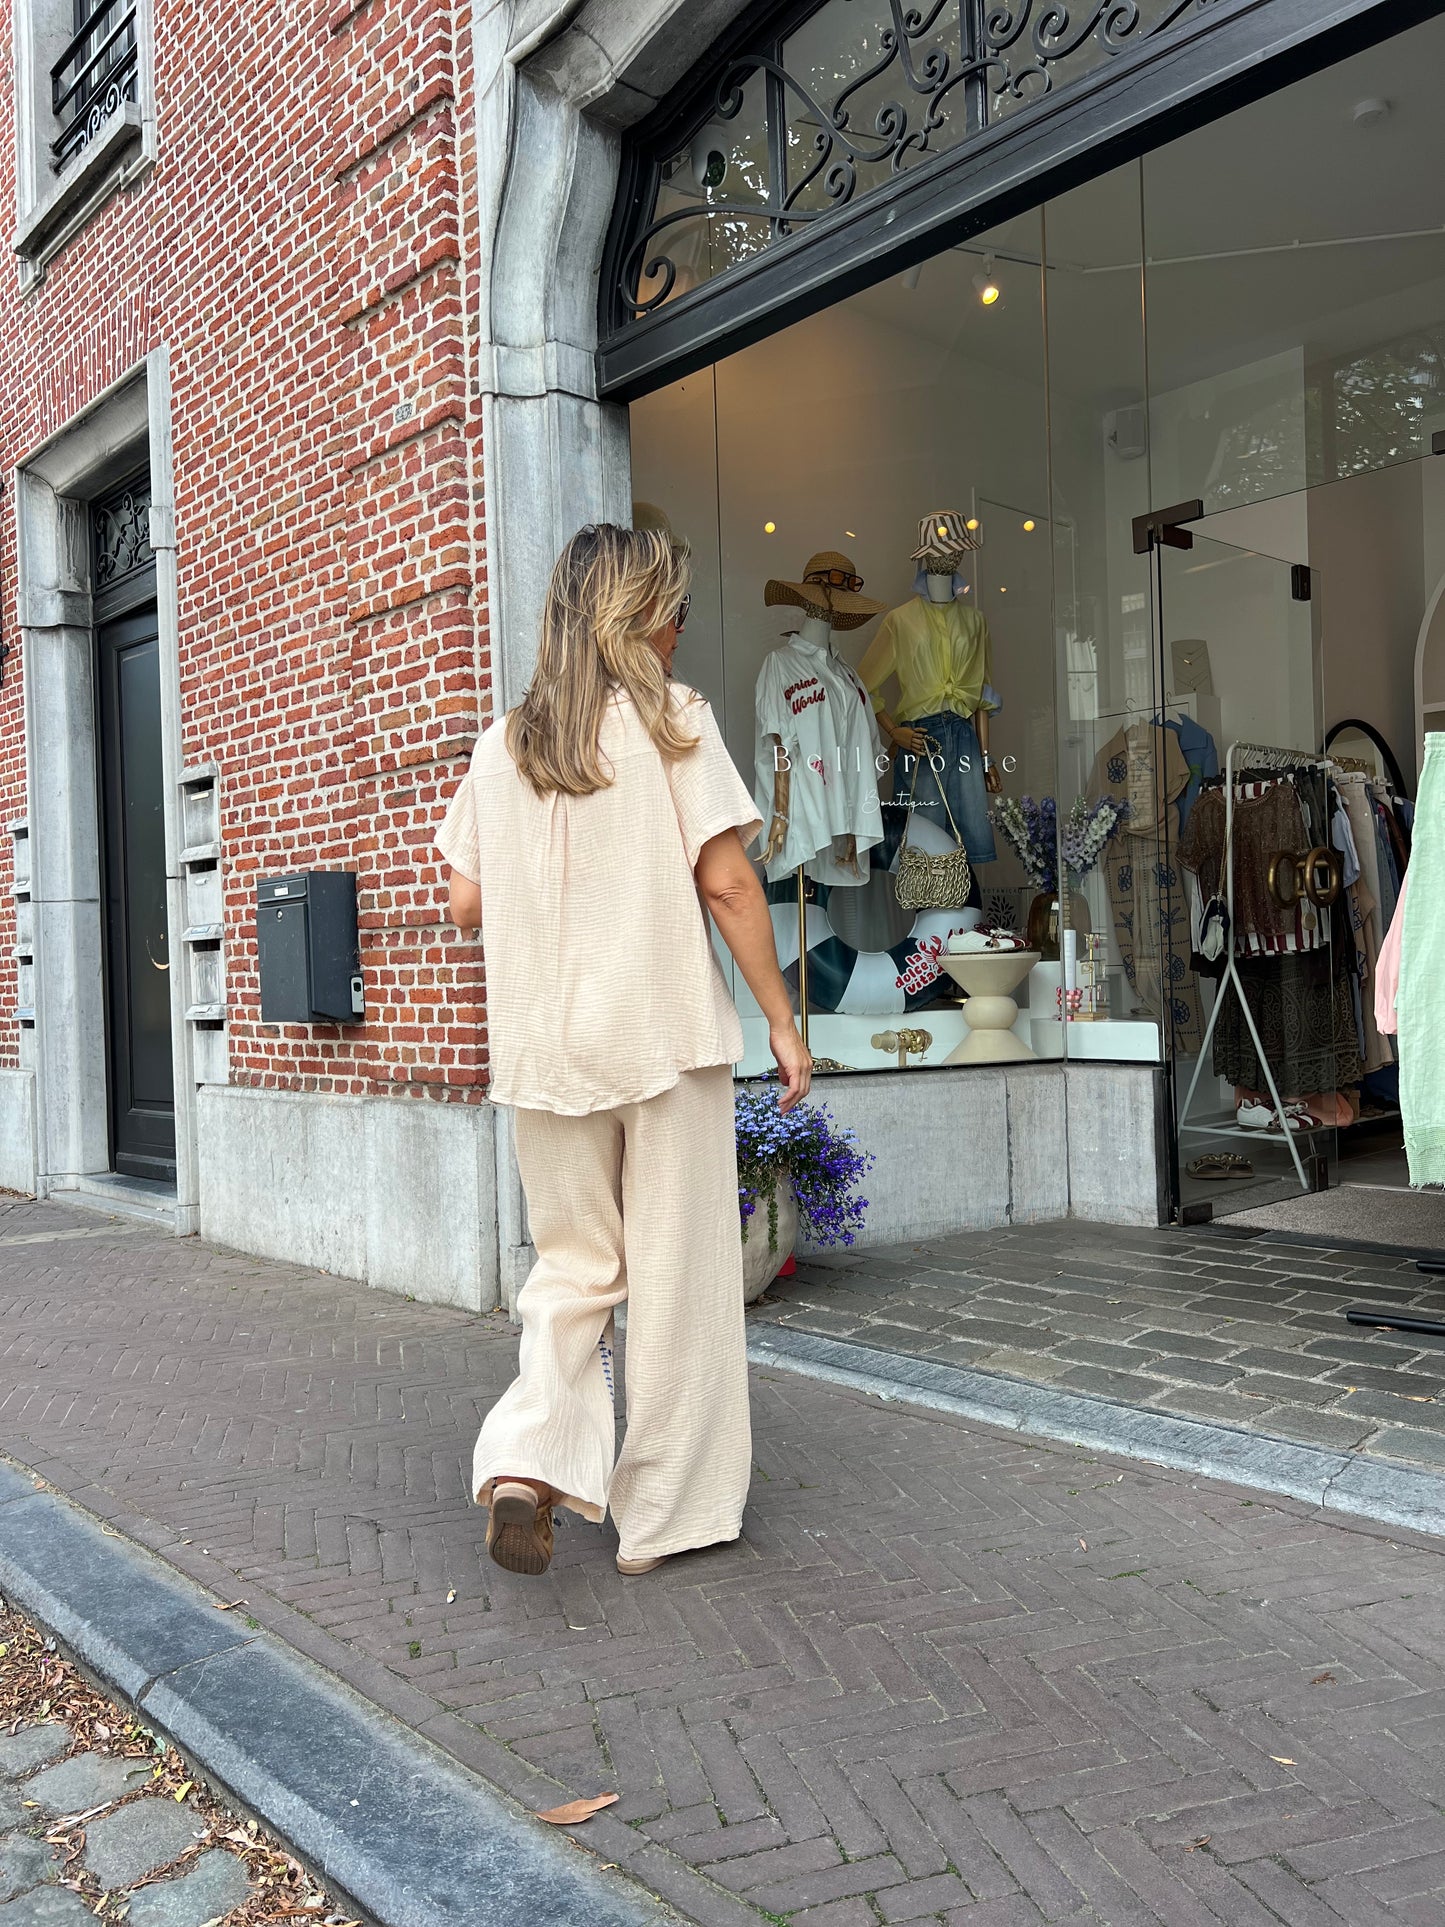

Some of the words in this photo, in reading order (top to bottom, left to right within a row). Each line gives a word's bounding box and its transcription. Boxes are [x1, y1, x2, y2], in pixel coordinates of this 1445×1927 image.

[791, 687, 826, 715] World
[773, 745, 1017, 773] Bellerosie
[861, 789, 940, 814] Boutique
[905, 953, 923, 966] la
[895, 962, 930, 989] dolce
[906, 971, 936, 994] vita
